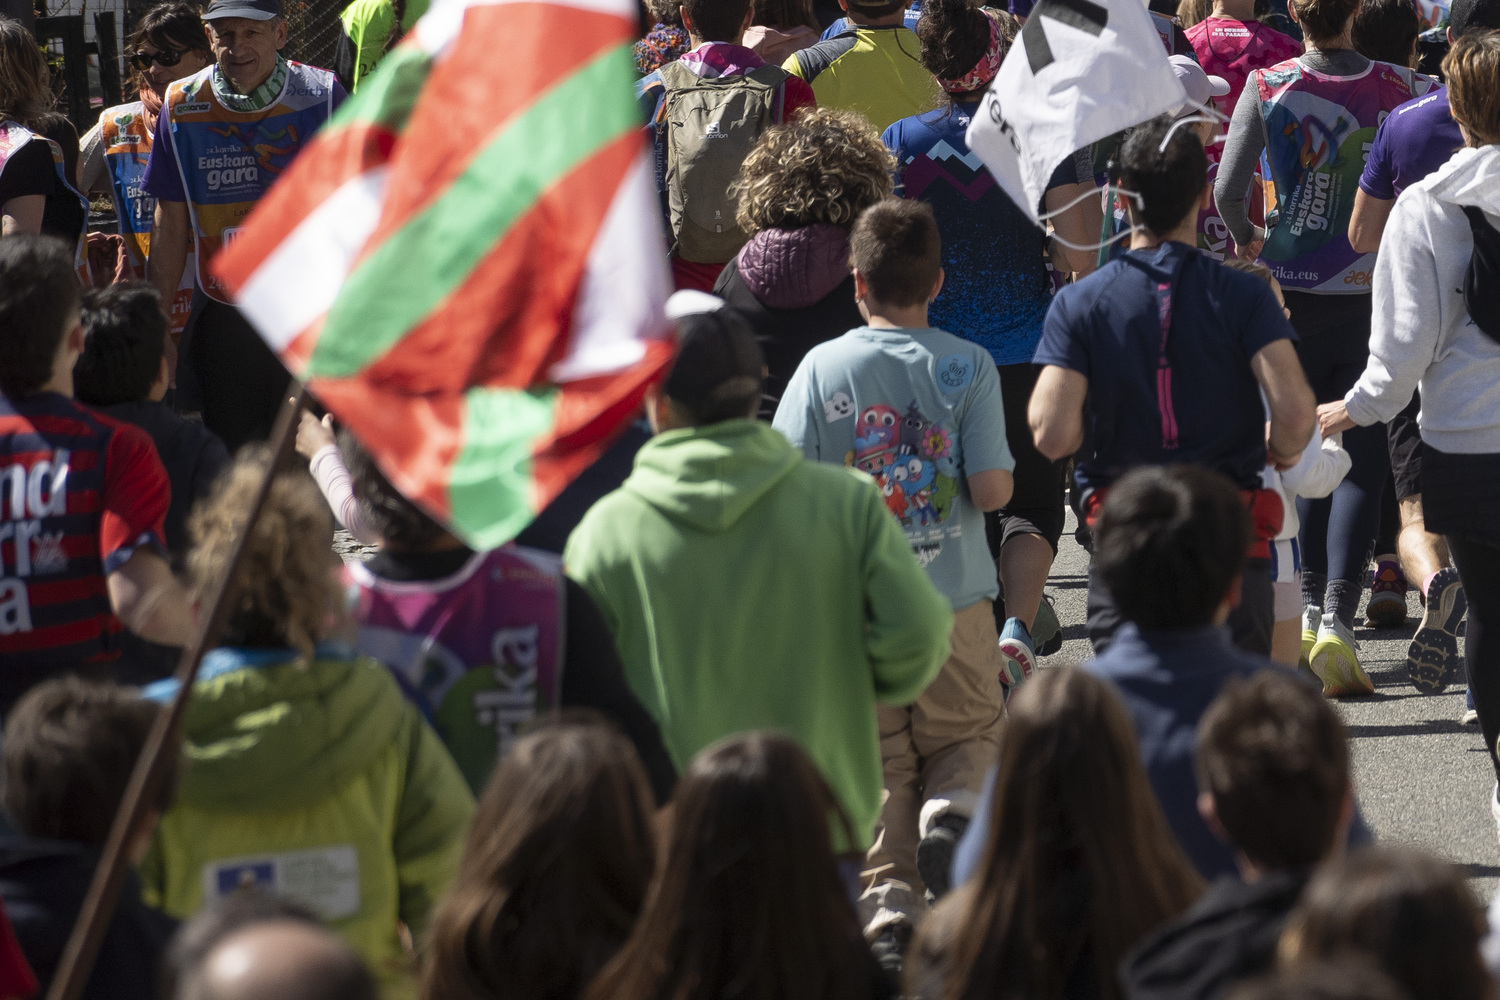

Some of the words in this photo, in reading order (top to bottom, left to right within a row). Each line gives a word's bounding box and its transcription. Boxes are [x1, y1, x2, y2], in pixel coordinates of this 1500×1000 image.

[297, 85, 325, 98] eitb
[698, 132, 728, 141] salomon
[198, 155, 255, 170] Euskara
[207, 168, 258, 191] gara
[1285, 185, 1301, 225] 24.korrika
[1290, 172, 1314, 237] Euskara
[1306, 172, 1331, 231] gara
